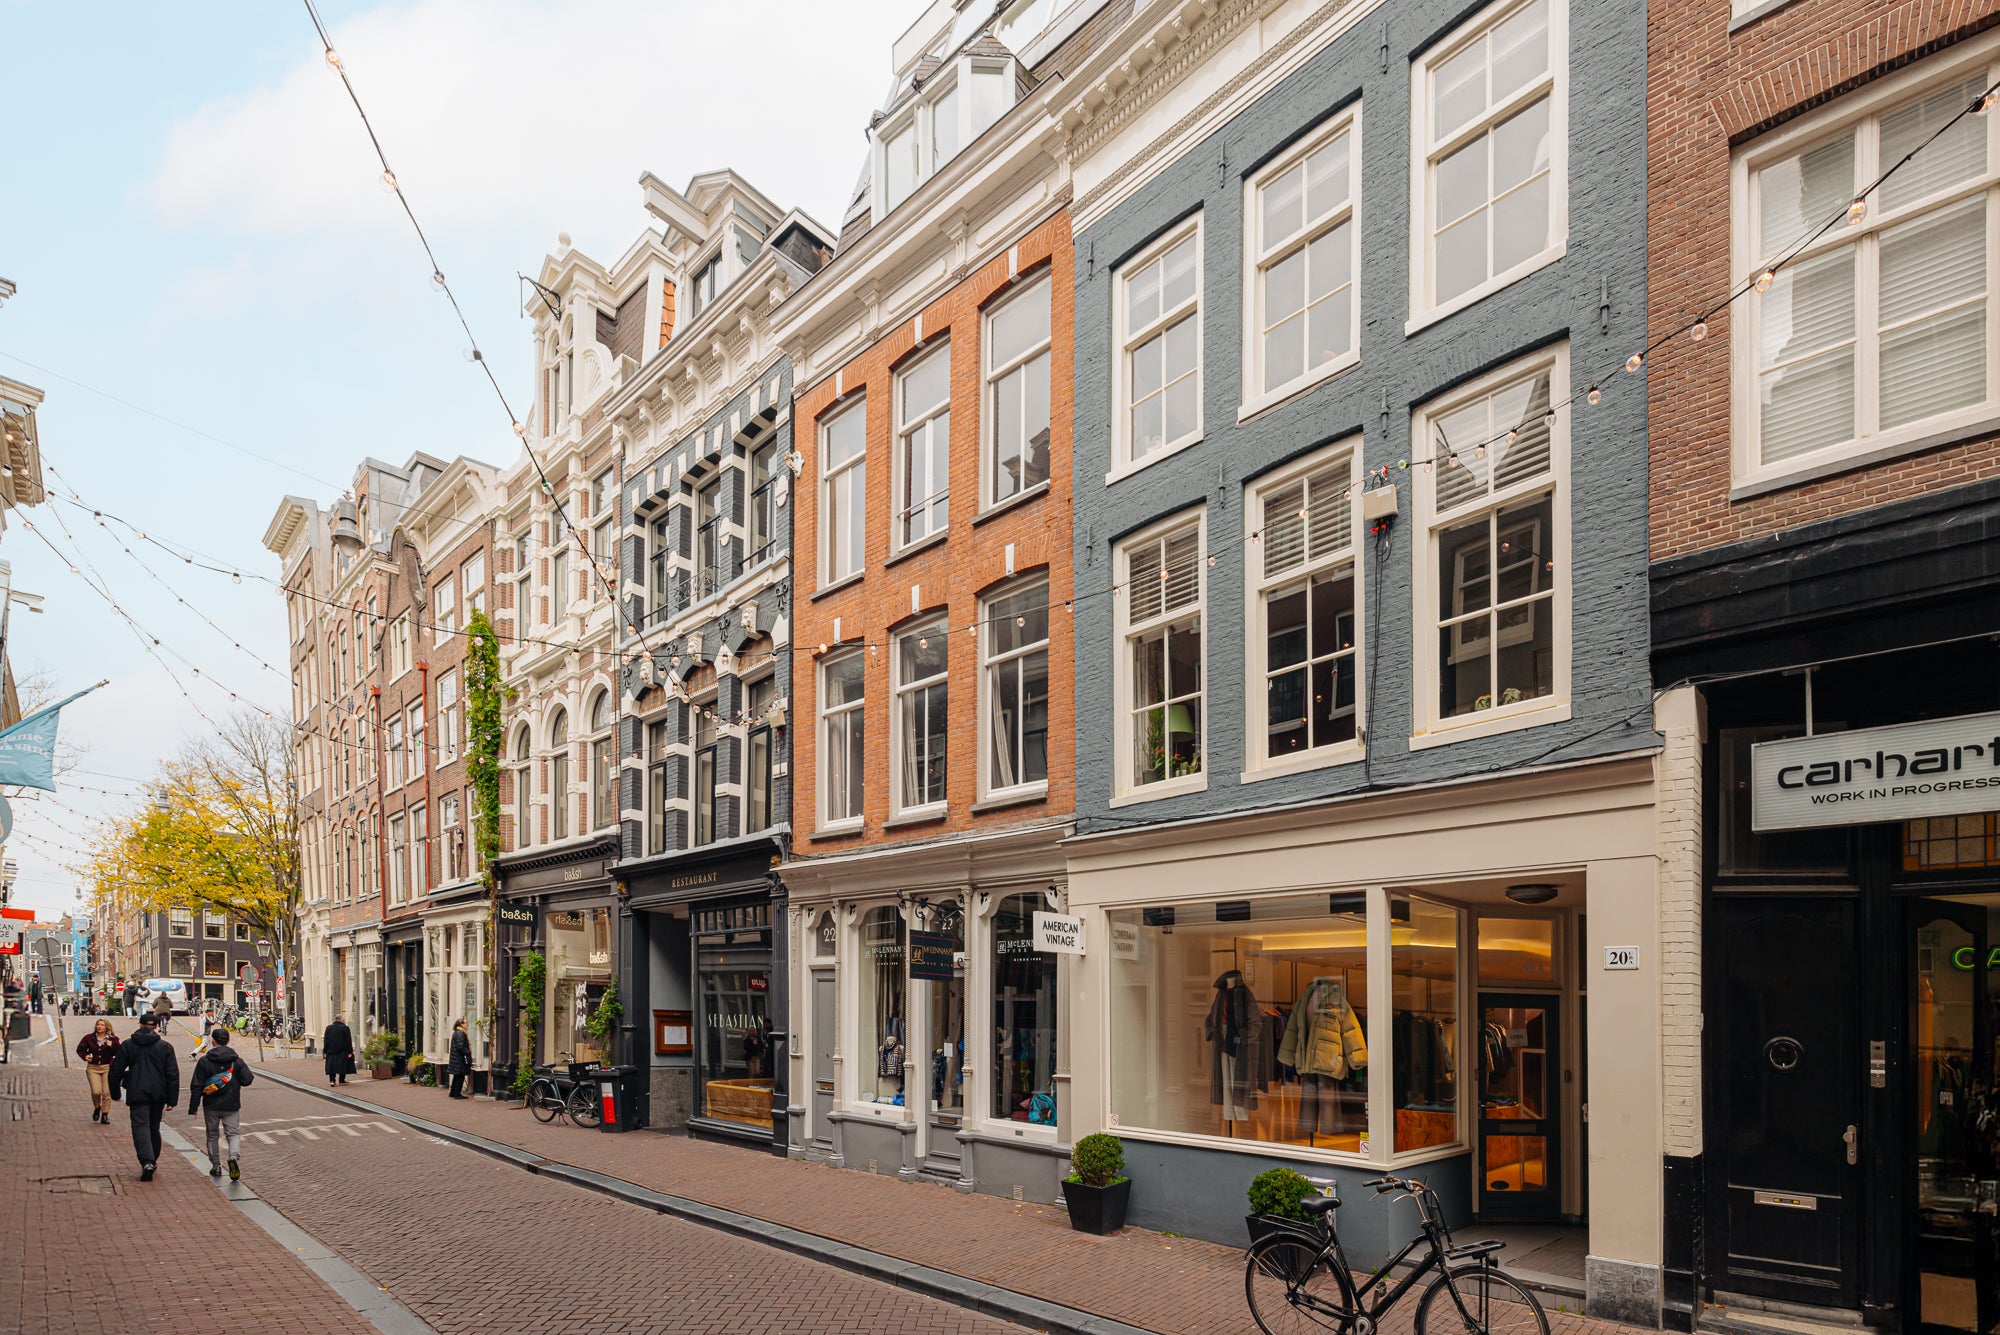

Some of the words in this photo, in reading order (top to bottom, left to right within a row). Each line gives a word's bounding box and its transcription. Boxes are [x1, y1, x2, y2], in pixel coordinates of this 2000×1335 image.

[1777, 736, 2000, 790] carhart
[1811, 791, 1865, 804] WORK
[1869, 788, 1886, 799] IN
[1892, 776, 2000, 796] PROGRESS
[564, 868, 582, 881] ba&sh
[671, 872, 718, 888] RESTAURANT
[501, 909, 533, 921] ba&sh
[1042, 920, 1079, 934] AMERICAN
[823, 928, 836, 942] 22
[1045, 933, 1075, 947] VINTAGE
[589, 952, 608, 964] ba&sh
[1610, 951, 1628, 965] 20
[708, 1013, 764, 1029] SEBASTIAN
[1940, 1091, 1953, 1105] OPEN
